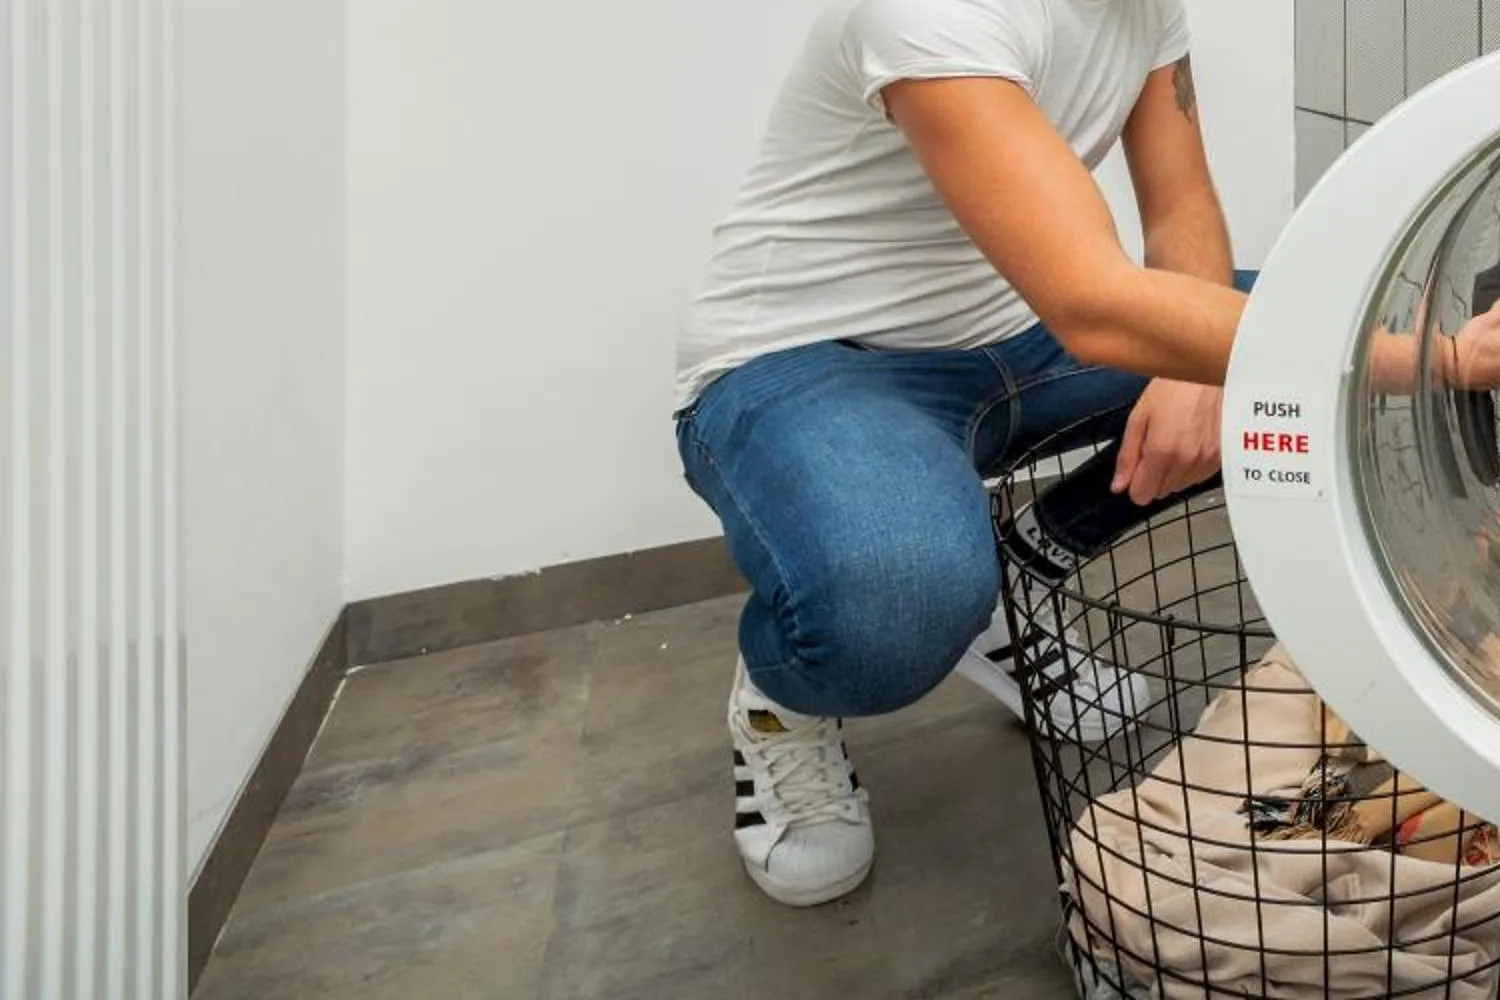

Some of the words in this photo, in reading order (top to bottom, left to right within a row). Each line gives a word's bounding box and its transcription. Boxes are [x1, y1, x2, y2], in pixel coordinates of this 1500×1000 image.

[1253, 401, 1301, 418] PUSH
[1243, 431, 1309, 453] HERE
[1244, 468, 1262, 481] TO
[1268, 469, 1311, 484] CLOSE
